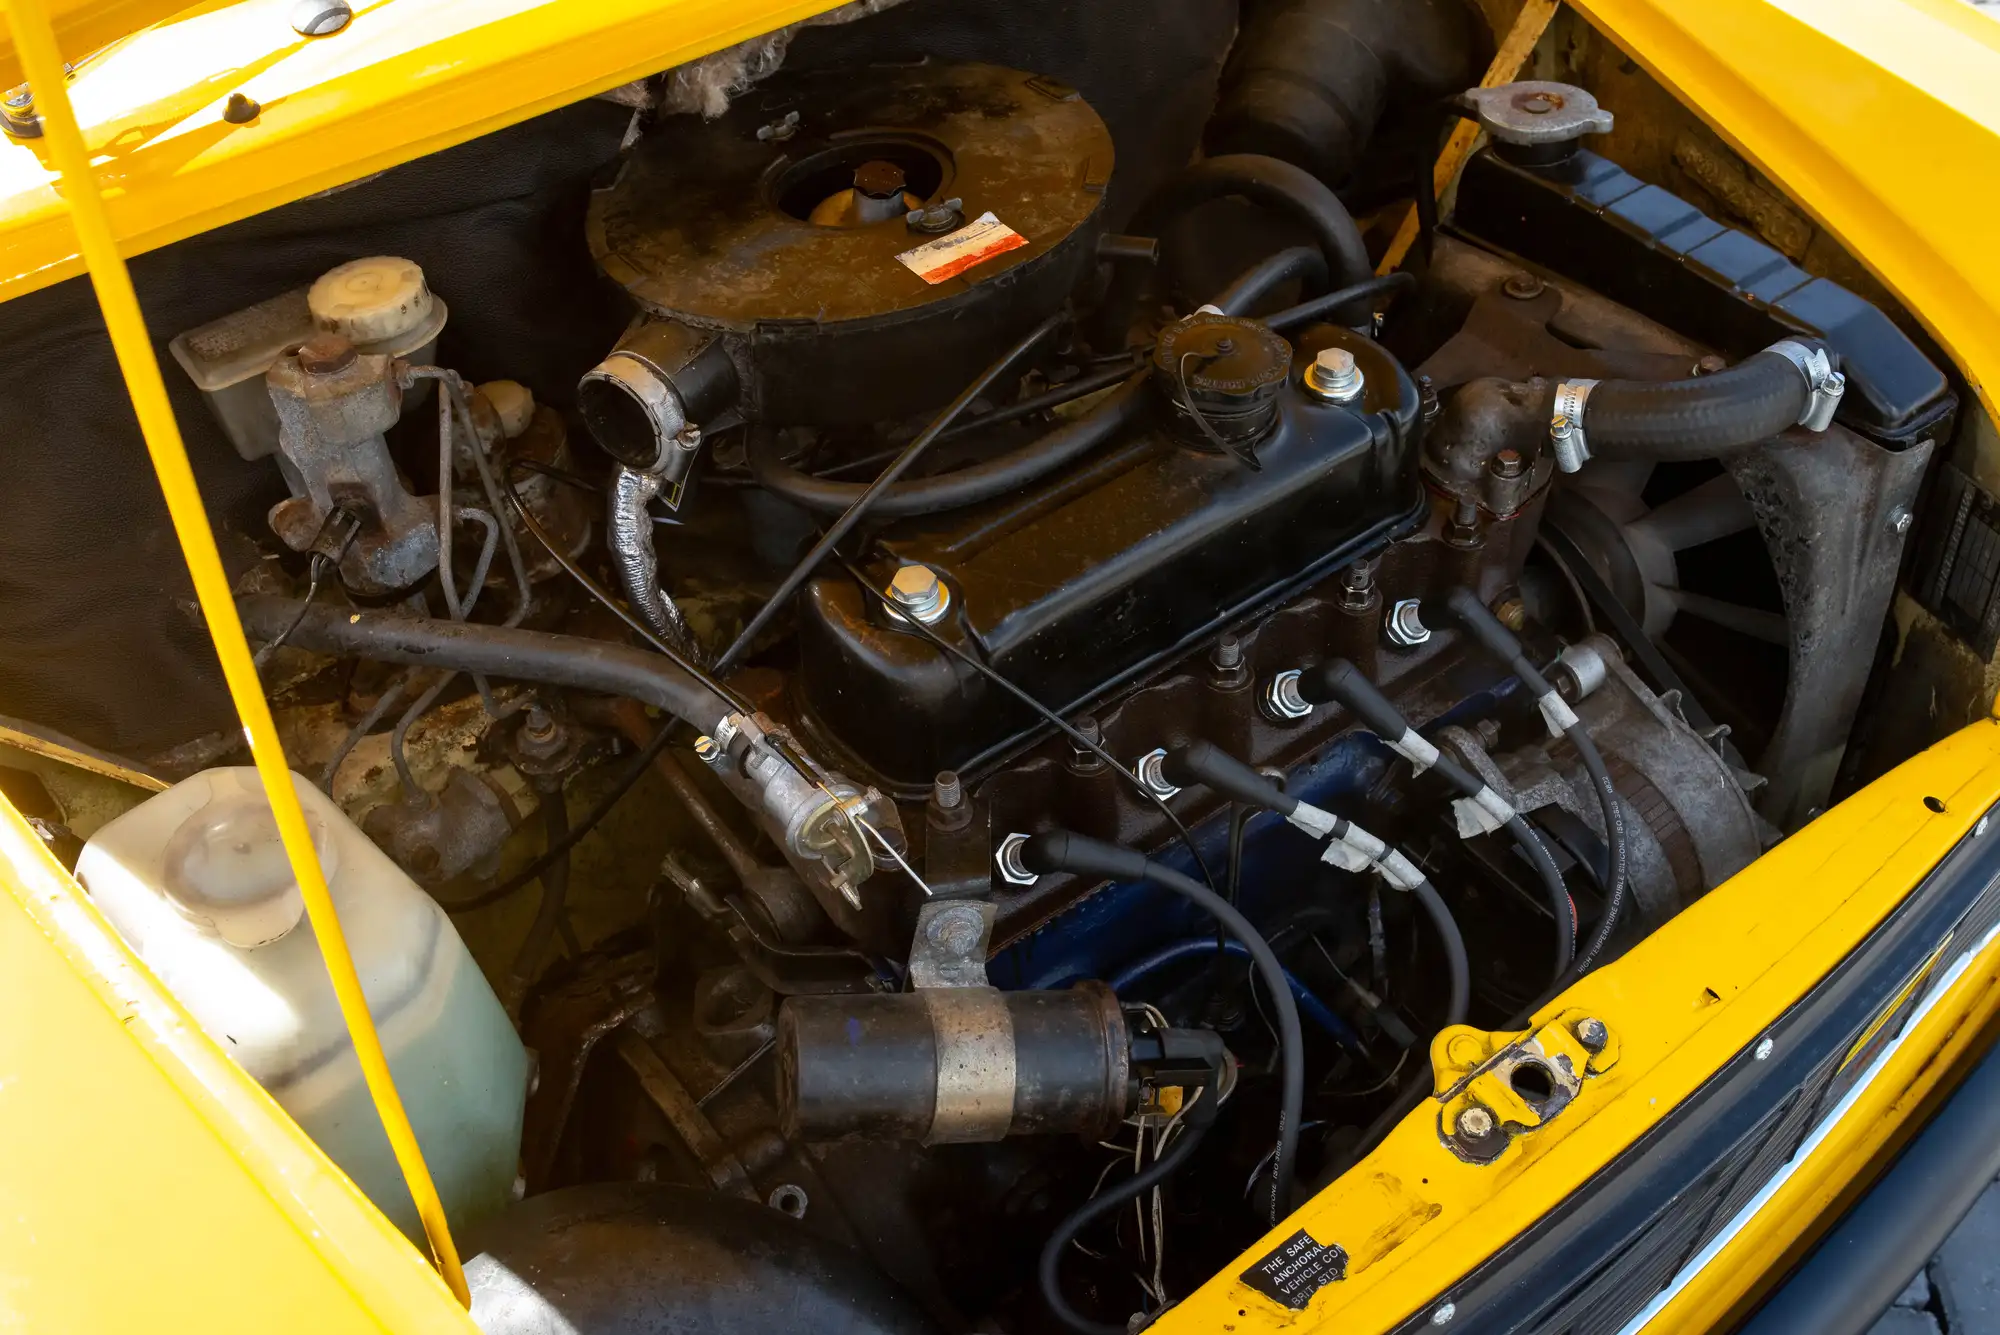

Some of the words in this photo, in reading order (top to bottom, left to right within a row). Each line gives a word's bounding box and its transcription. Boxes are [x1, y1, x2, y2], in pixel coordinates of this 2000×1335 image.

[1616, 820, 1625, 834] ISO
[1618, 839, 1626, 874] SILICONE
[1613, 876, 1625, 906] DOUBLE
[1590, 907, 1618, 957] TEMPERATURE
[1577, 956, 1593, 974] HIGH
[1261, 1257, 1285, 1275] THE
[1286, 1235, 1313, 1257] SAFE
[1281, 1261, 1323, 1295] VEHICLE
